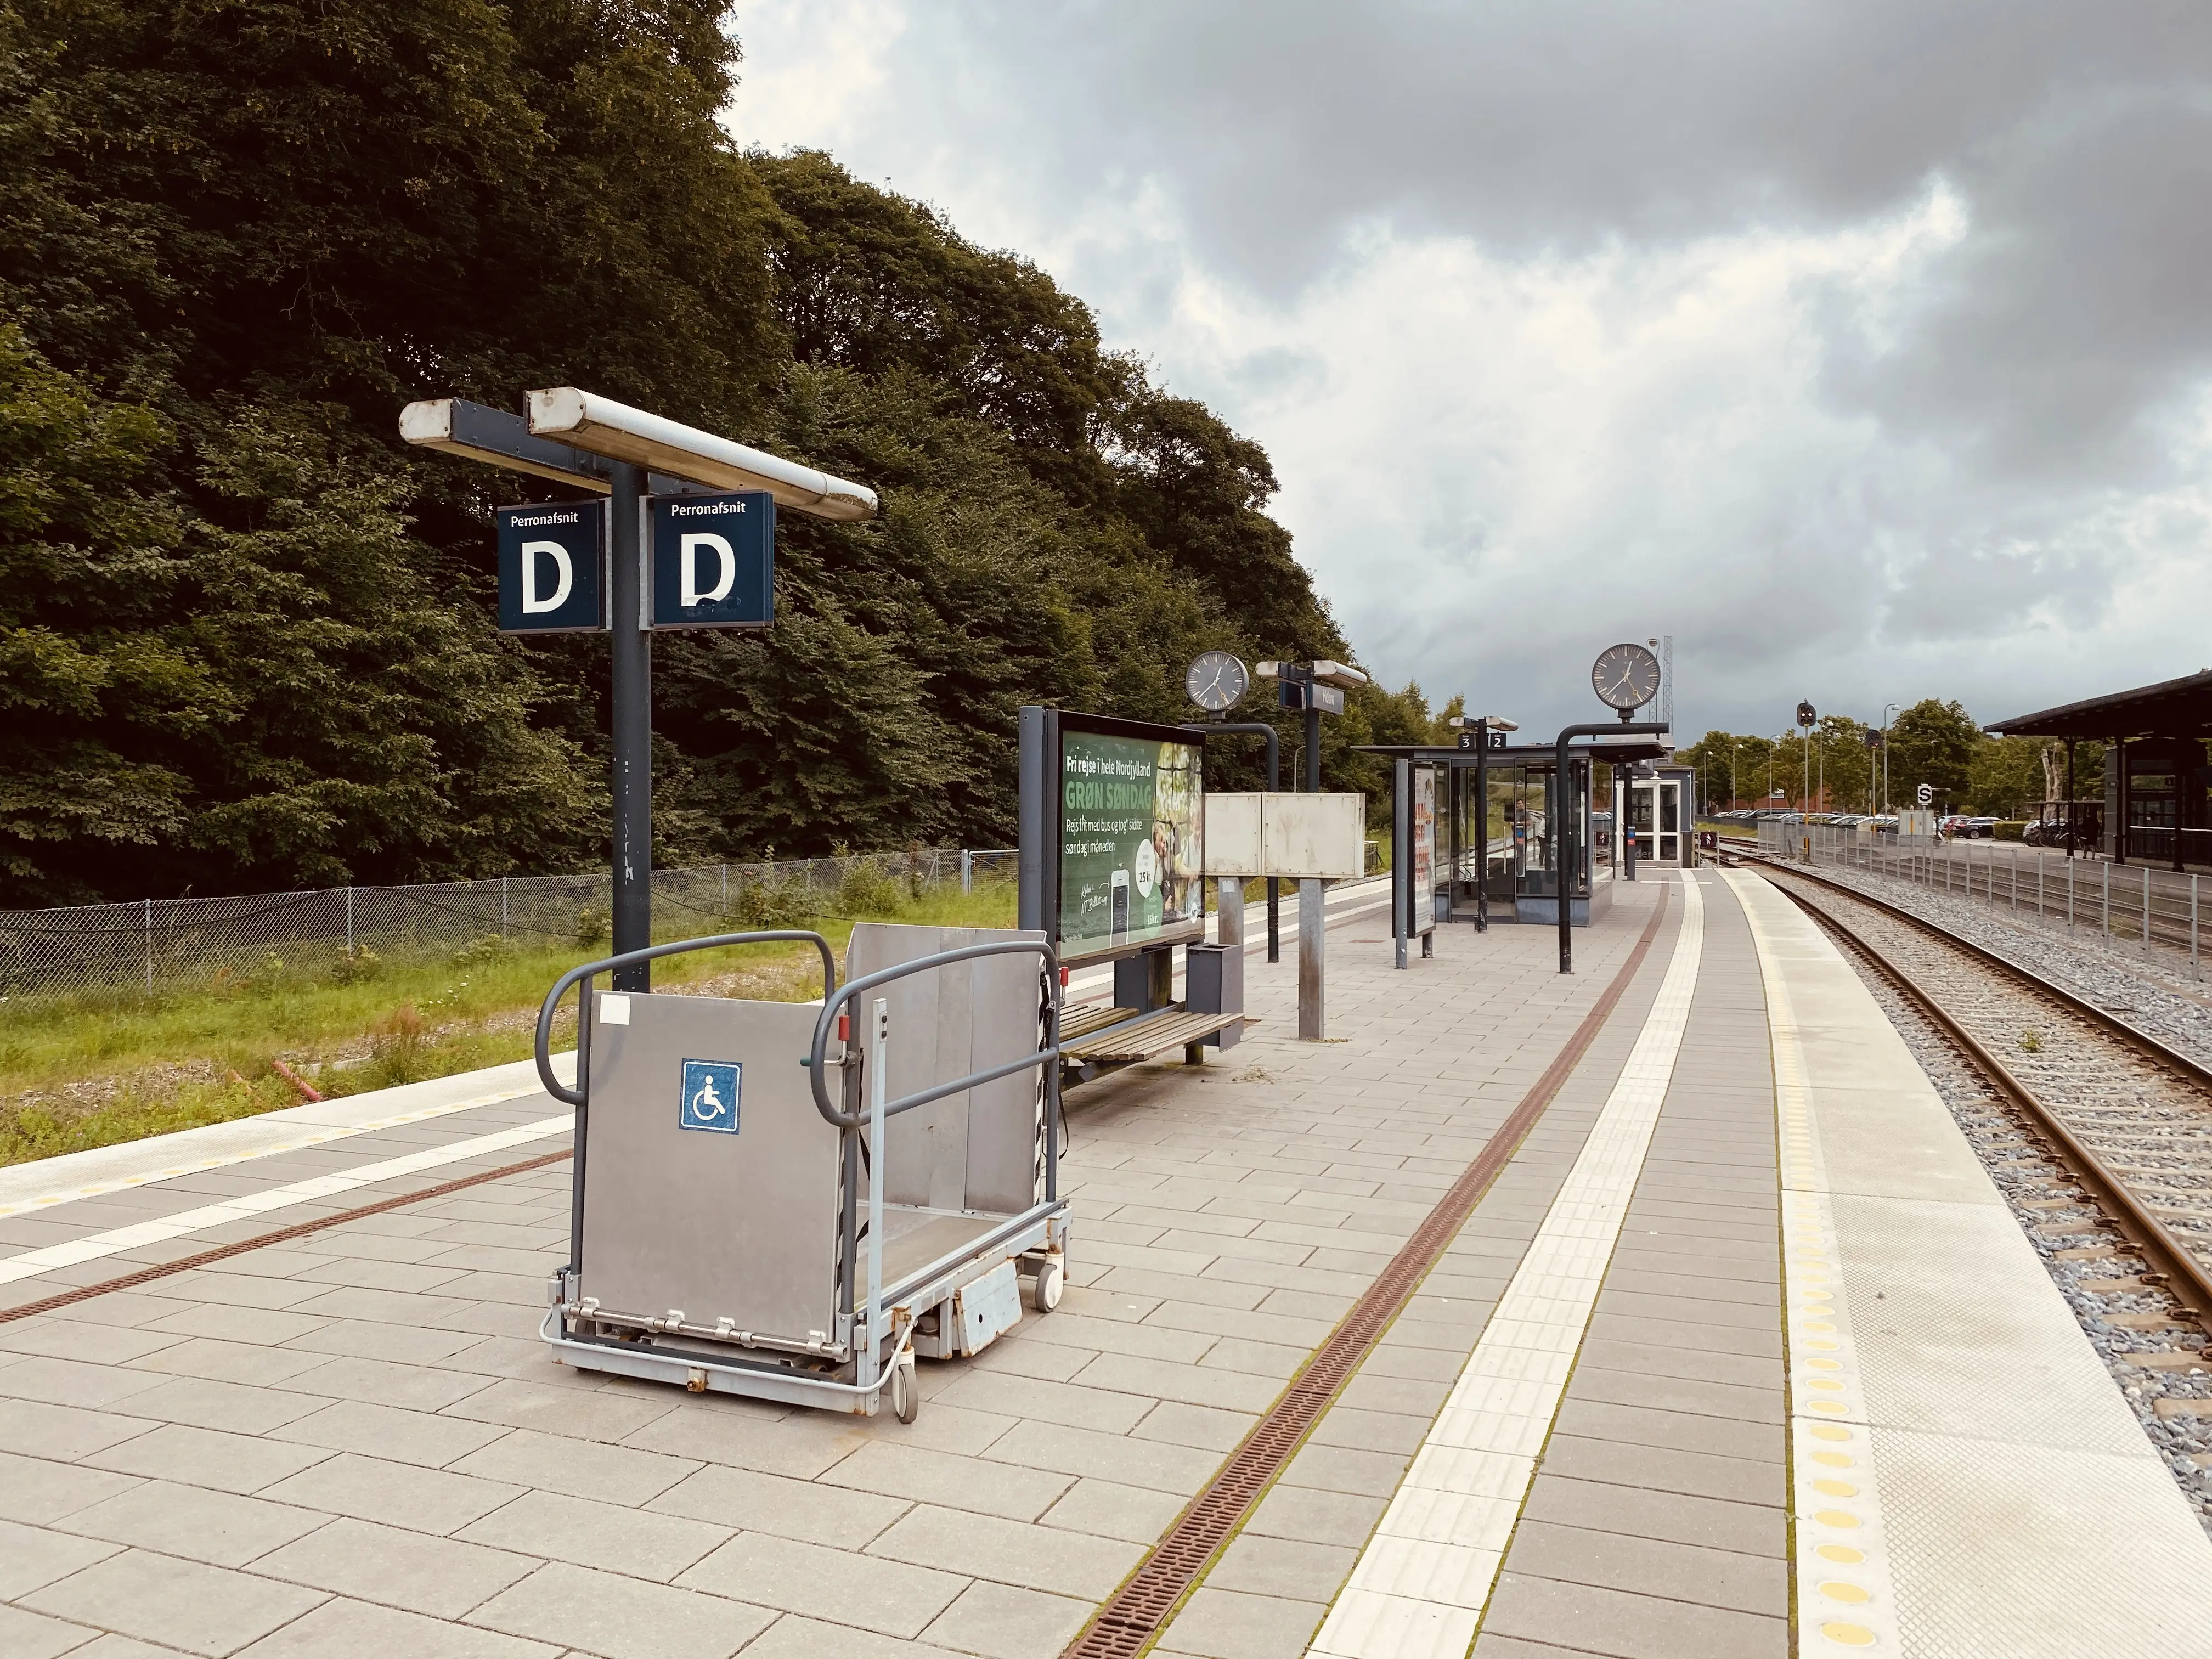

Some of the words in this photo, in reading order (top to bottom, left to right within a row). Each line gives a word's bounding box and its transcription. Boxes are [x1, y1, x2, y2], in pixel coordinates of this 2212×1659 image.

[671, 501, 746, 516] Perronafsnit
[511, 511, 578, 527] Perronafsnit
[522, 541, 573, 614] D
[681, 533, 736, 607] D
[1323, 689, 1335, 706] Hobro
[1463, 738, 1470, 748] 3
[1494, 737, 1502, 747] 2
[1066, 754, 1077, 772] Fri
[1078, 755, 1096, 777] rejse
[1097, 757, 1100, 774] i
[1101, 758, 1115, 775] hele
[1116, 760, 1151, 780] Nordjylland
[1065, 781, 1103, 810] GRØN
[1106, 782, 1152, 810] SØNDAG
[1918, 788, 1931, 802] S
[1066, 819, 1079, 836] Rejs
[1079, 814, 1087, 832] frit
[1088, 818, 1100, 832] med
[1101, 818, 1111, 832] bus
[1111, 821, 1118, 834] og
[1065, 840, 1087, 857] søndag
[1087, 840, 1090, 853] i
[1090, 838, 1115, 853] måneden
[1139, 872, 1146, 883] 25
[1147, 915, 1152, 926] 15
